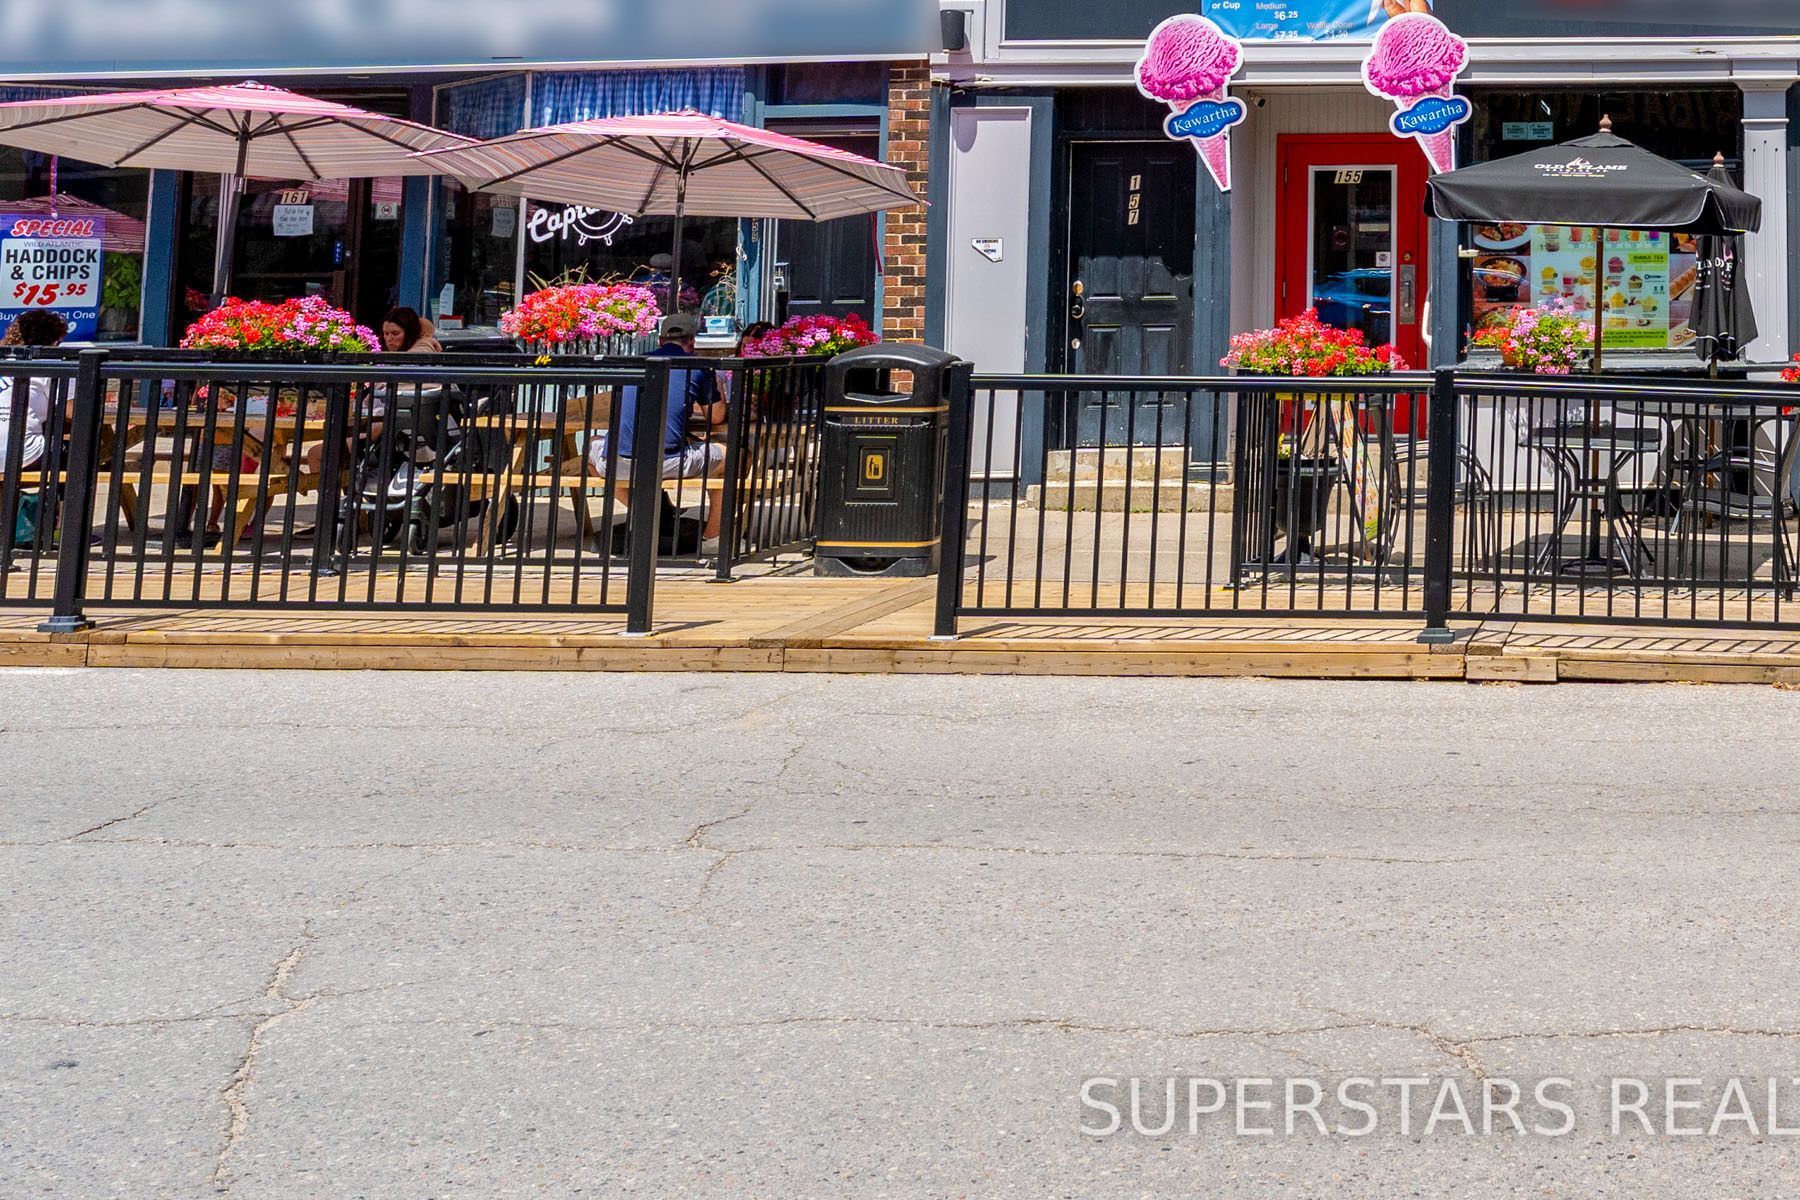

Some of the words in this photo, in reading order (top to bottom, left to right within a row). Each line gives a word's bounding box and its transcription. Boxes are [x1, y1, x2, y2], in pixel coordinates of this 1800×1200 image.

[1223, 1, 1240, 10] Cup
[1274, 11, 1298, 20] $6.25
[1256, 22, 1278, 31] Large
[1274, 31, 1298, 40] $7.25
[1173, 108, 1237, 134] Kawartha
[1400, 104, 1463, 130] Kawartha
[1338, 170, 1361, 182] 155
[284, 191, 307, 203] 161
[1130, 176, 1139, 224] 157
[11, 219, 95, 236] SPECIAL
[5, 248, 98, 264] HADDOCK
[10, 265, 24, 280] &
[32, 265, 90, 280] CHIPS
[12, 282, 87, 306] $15.95
[73, 310, 95, 319] One
[854, 416, 899, 425] LITTER
